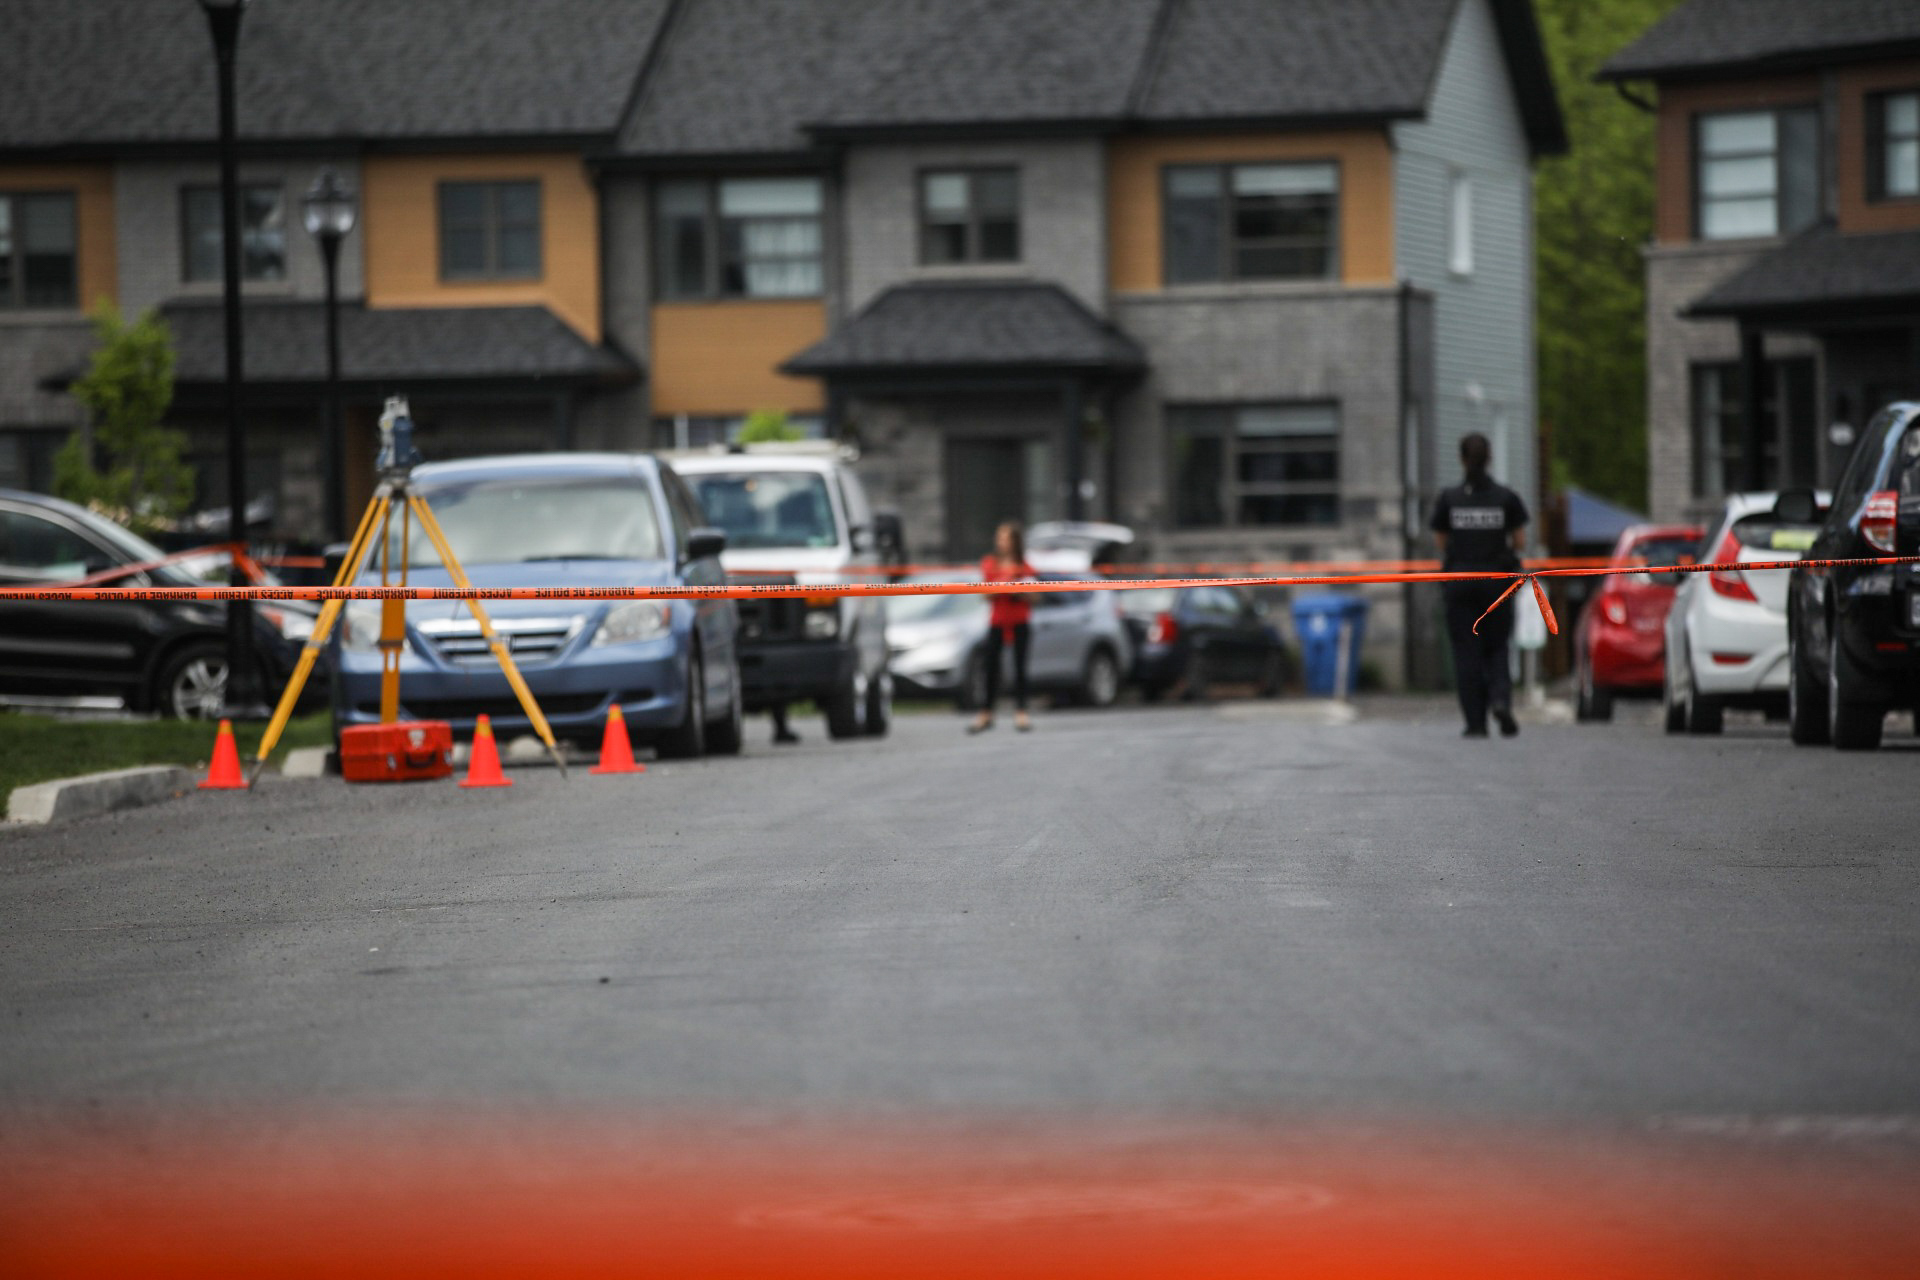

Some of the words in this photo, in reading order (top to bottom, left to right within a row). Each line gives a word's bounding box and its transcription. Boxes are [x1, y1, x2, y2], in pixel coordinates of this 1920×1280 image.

[213, 591, 258, 600] INTERDIT
[316, 590, 352, 599] POLICE
[354, 590, 368, 599] DE
[370, 589, 417, 599] BARRAGE
[432, 588, 477, 599] INTERDIT
